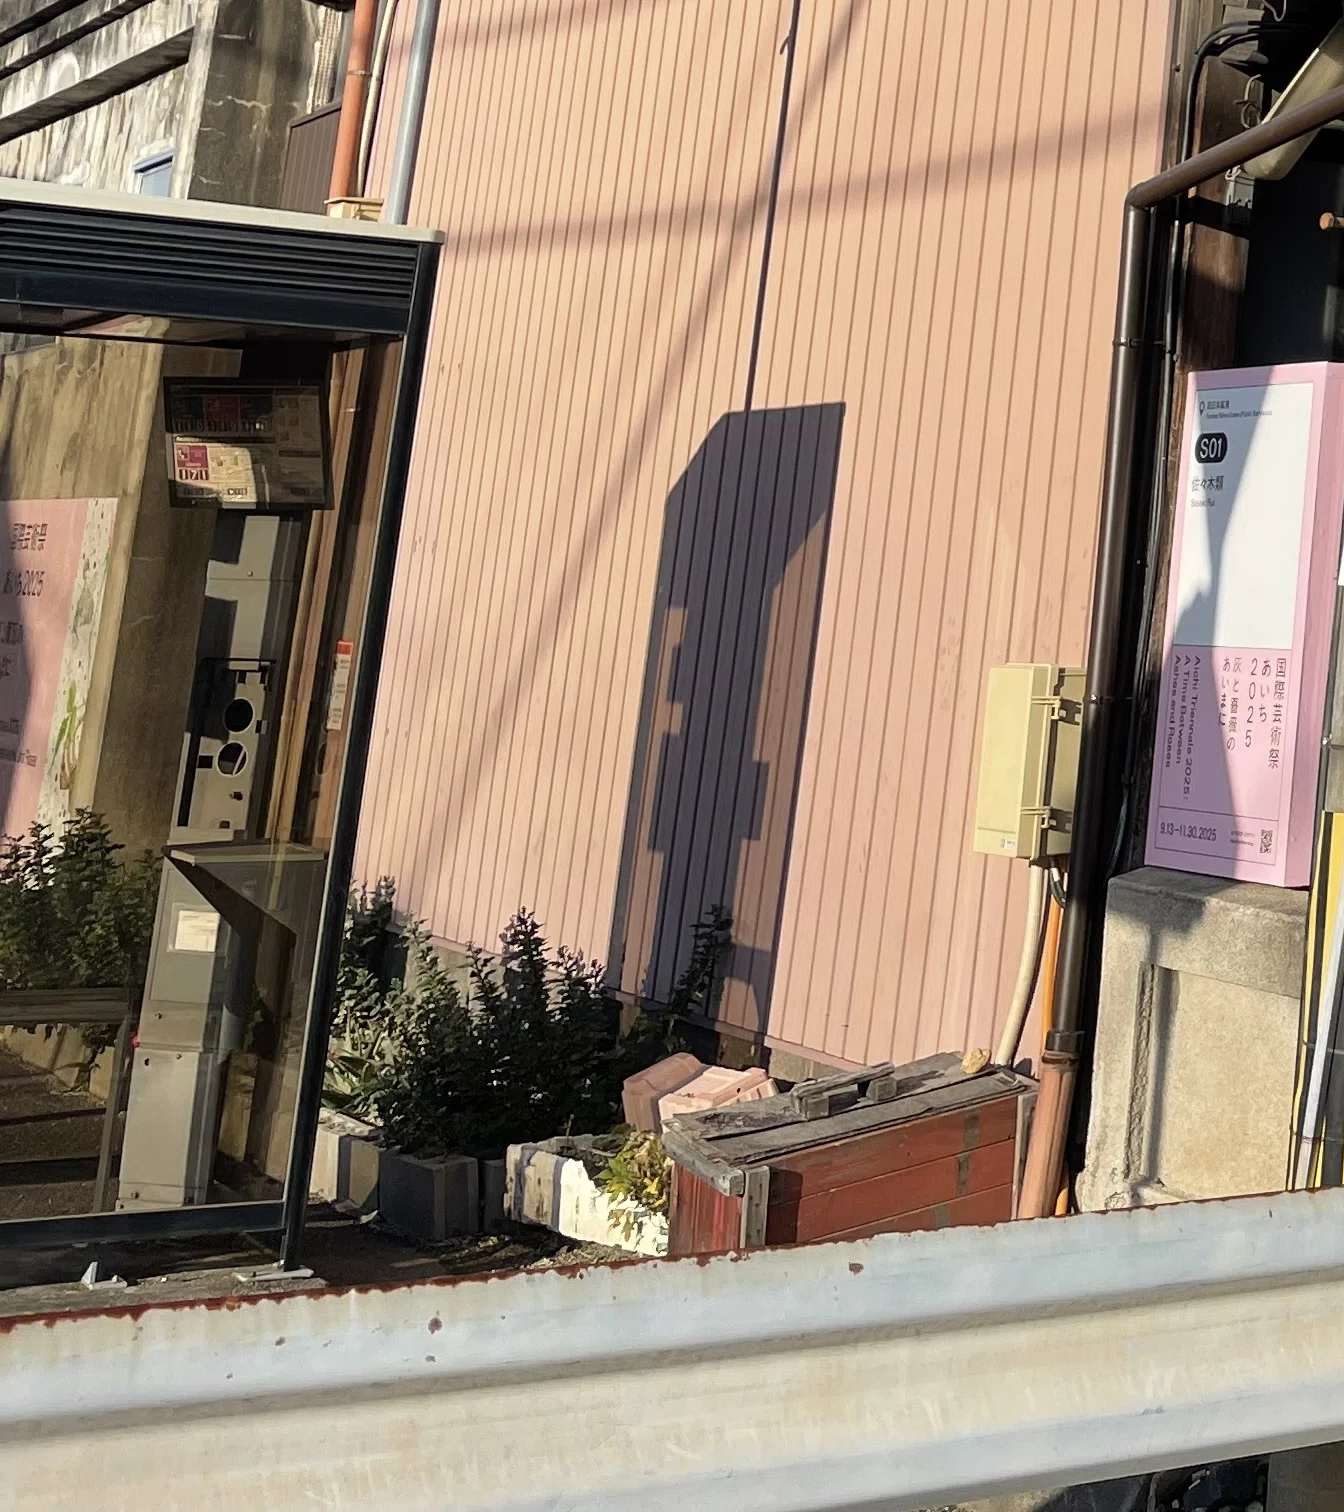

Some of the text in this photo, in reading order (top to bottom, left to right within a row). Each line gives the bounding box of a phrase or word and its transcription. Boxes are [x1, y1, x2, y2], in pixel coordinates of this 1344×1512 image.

[1200, 437, 1222, 459] S01
[1183, 655, 1191, 666] A
[1193, 655, 1201, 691] Aichi
[1258, 657, 1272, 723] あいち
[1186, 694, 1198, 755] Triennale
[1245, 657, 1258, 748] 2025
[1268, 657, 1287, 769] 国際芸術祭
